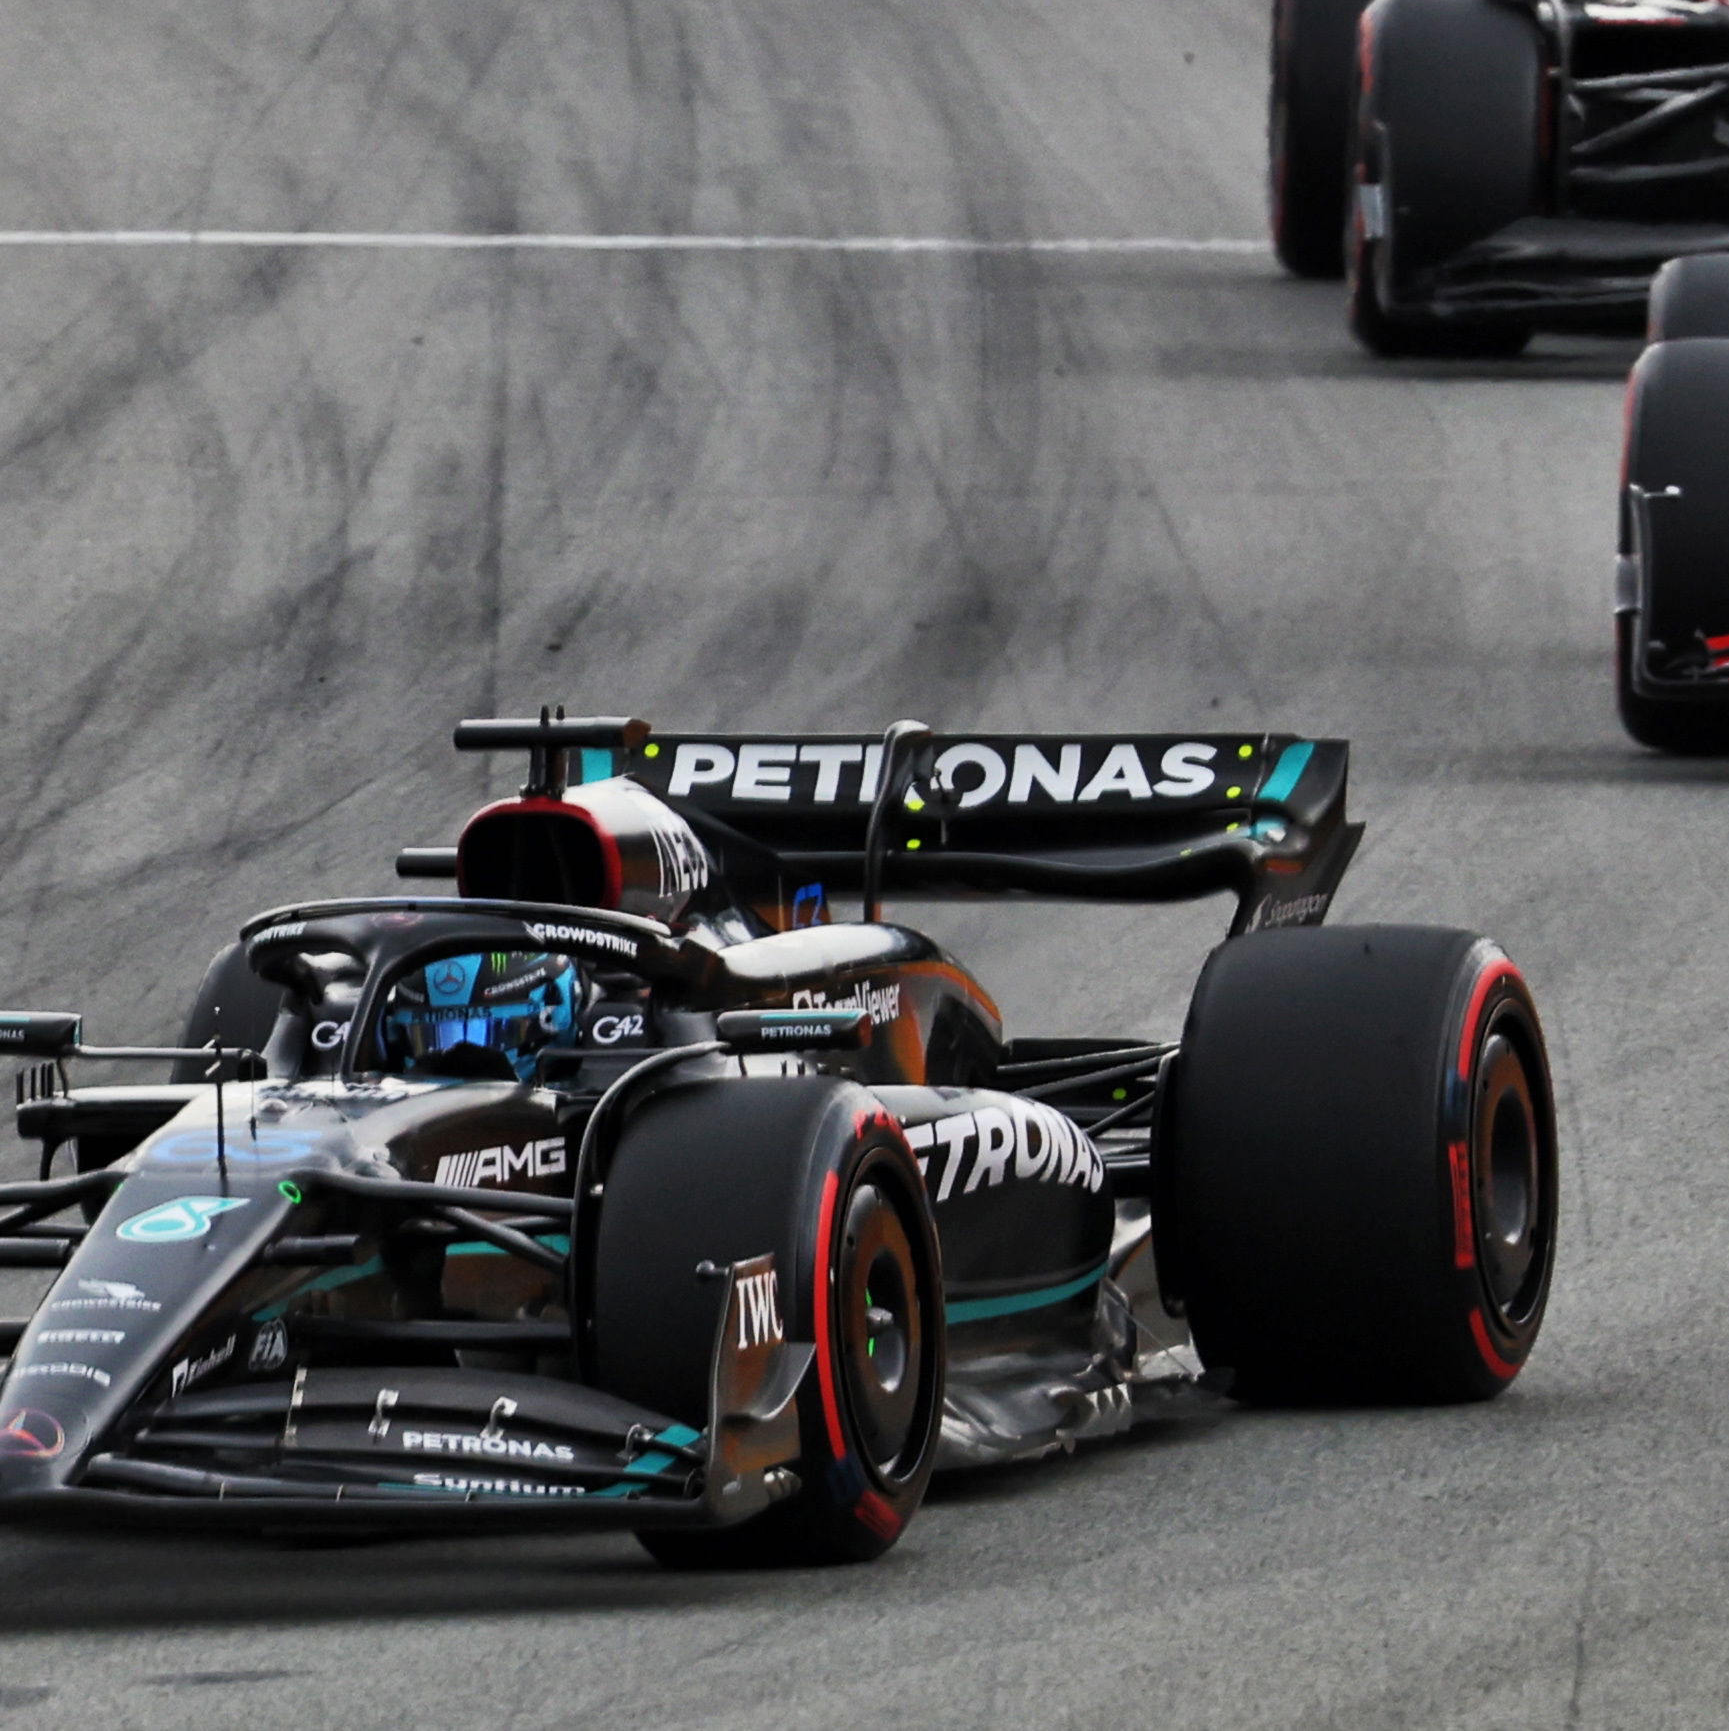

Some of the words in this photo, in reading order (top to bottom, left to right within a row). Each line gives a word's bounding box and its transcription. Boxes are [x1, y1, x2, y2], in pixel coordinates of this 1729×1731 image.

[668, 742, 1217, 807] PETONAS
[533, 922, 639, 958] CROWDSTRIKE
[592, 1014, 645, 1044] G42
[760, 1023, 832, 1039] PETRONAS
[470, 1136, 566, 1187] AMG
[736, 1269, 784, 1349] IWC
[402, 1430, 575, 1460] PETRONAS
